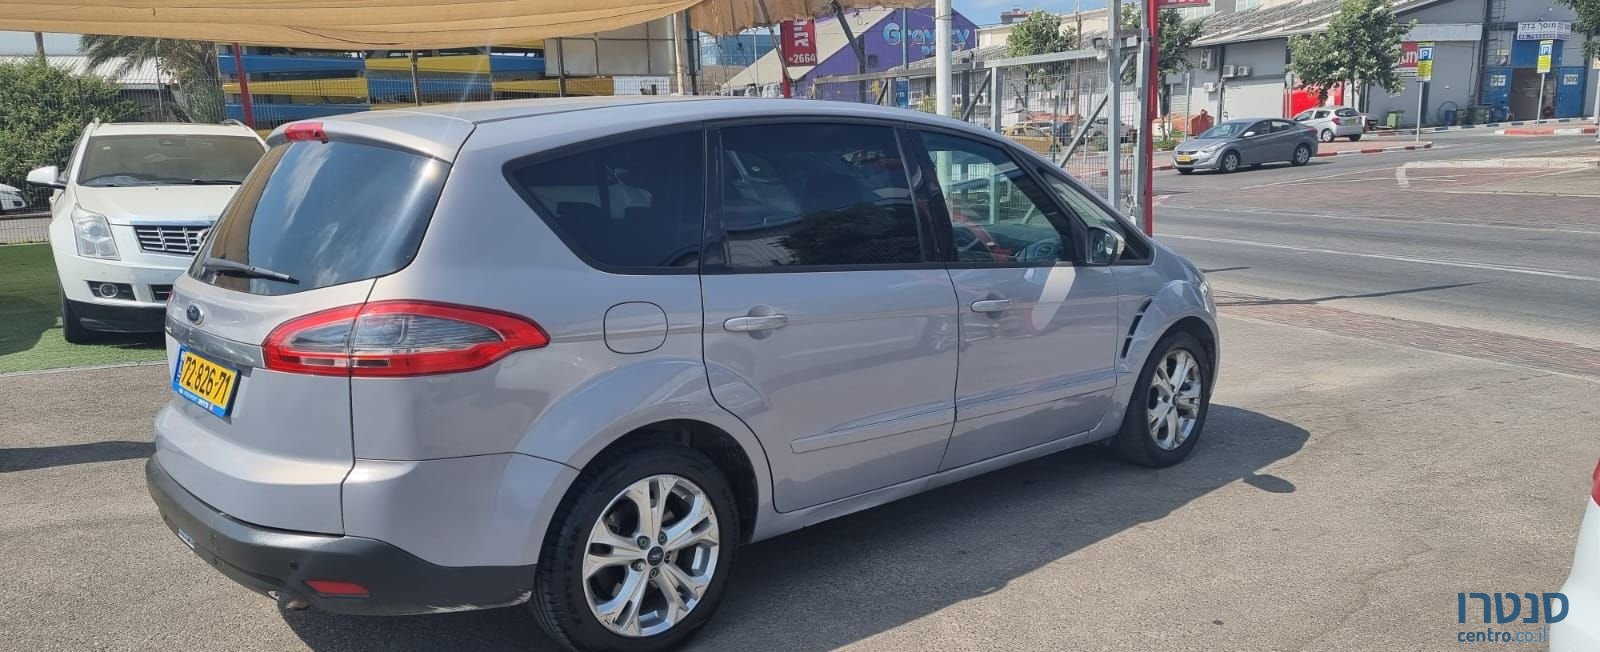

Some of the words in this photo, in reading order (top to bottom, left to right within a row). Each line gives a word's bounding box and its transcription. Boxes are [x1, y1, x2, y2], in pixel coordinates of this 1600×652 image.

[1521, 23, 1536, 31] בזק
[1538, 22, 1556, 30] מוסך
[883, 22, 970, 46] Gravy
